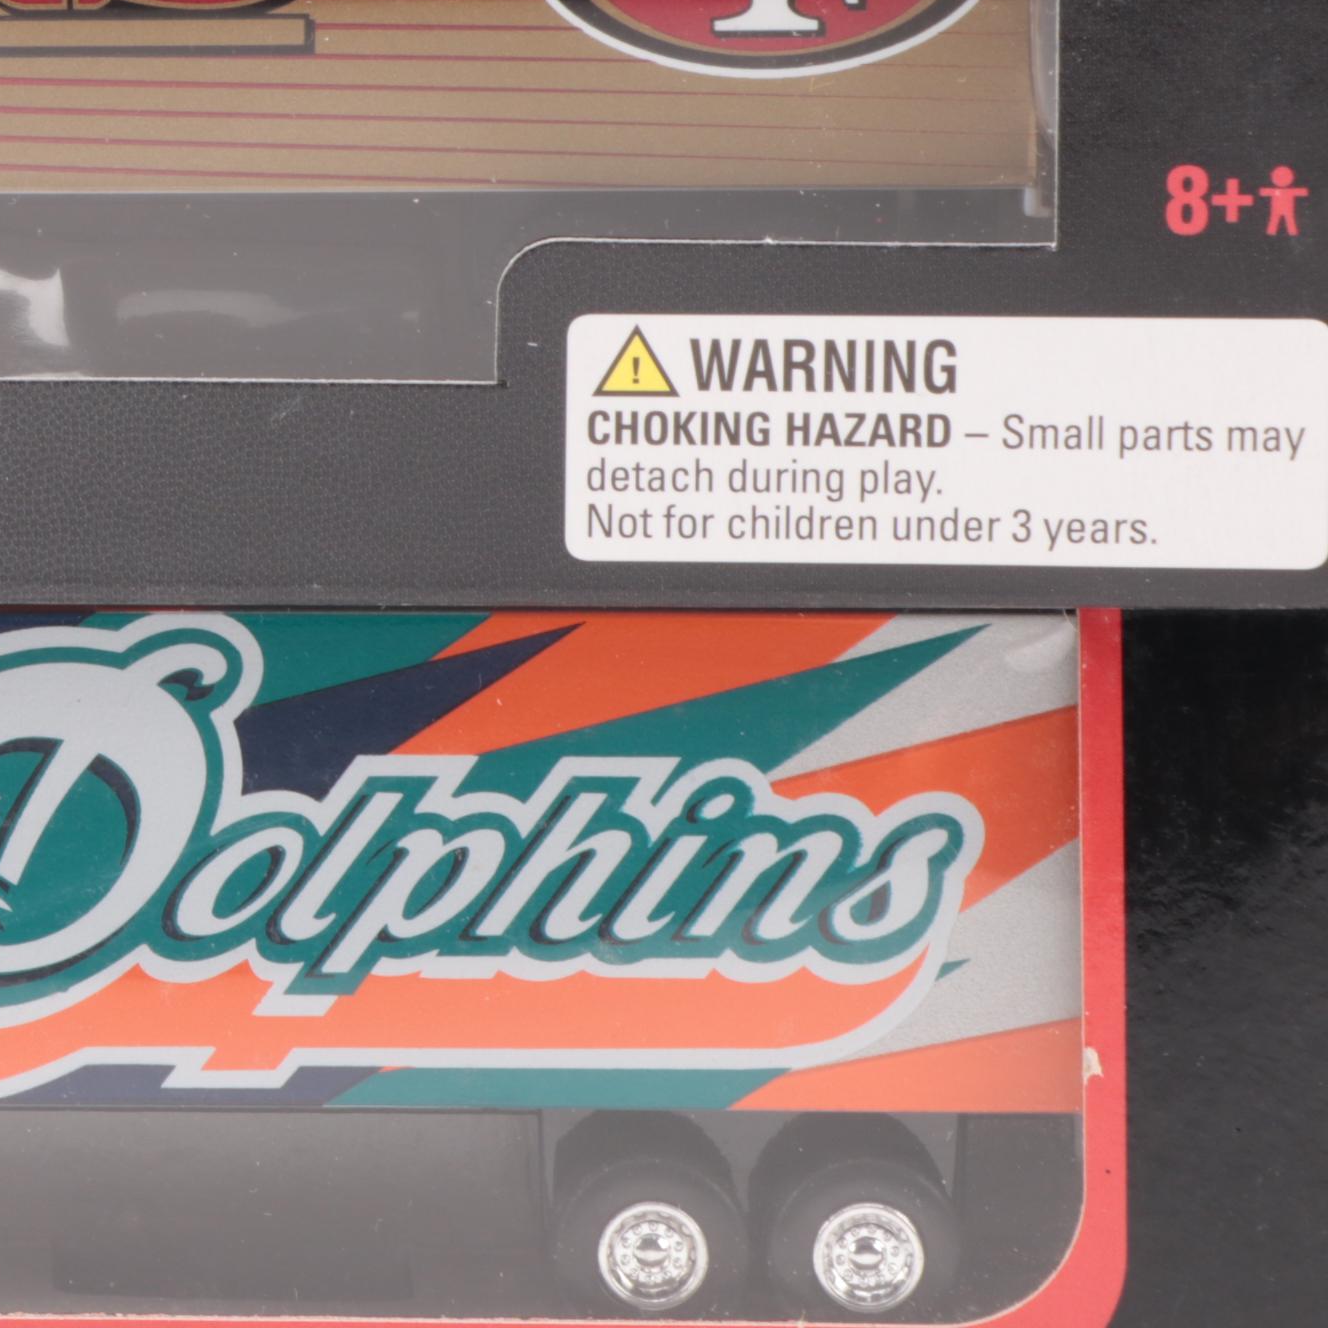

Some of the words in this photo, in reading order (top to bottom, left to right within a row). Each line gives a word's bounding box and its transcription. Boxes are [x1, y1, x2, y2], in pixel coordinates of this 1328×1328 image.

[689, 338, 957, 394] WARNING
[587, 409, 771, 446] CHOKING
[786, 412, 952, 448] HAZARD
[1002, 414, 1104, 450] Small
[1118, 420, 1214, 460] parts
[1227, 425, 1306, 461] may
[587, 457, 714, 493] detach
[728, 458, 845, 502] during
[859, 460, 944, 503] play.
[587, 503, 654, 539] Not
[663, 503, 715, 540] for
[727, 504, 878, 541] children
[892, 507, 1001, 542] under
[1011, 509, 1032, 543] 3
[1043, 518, 1158, 552] years.
